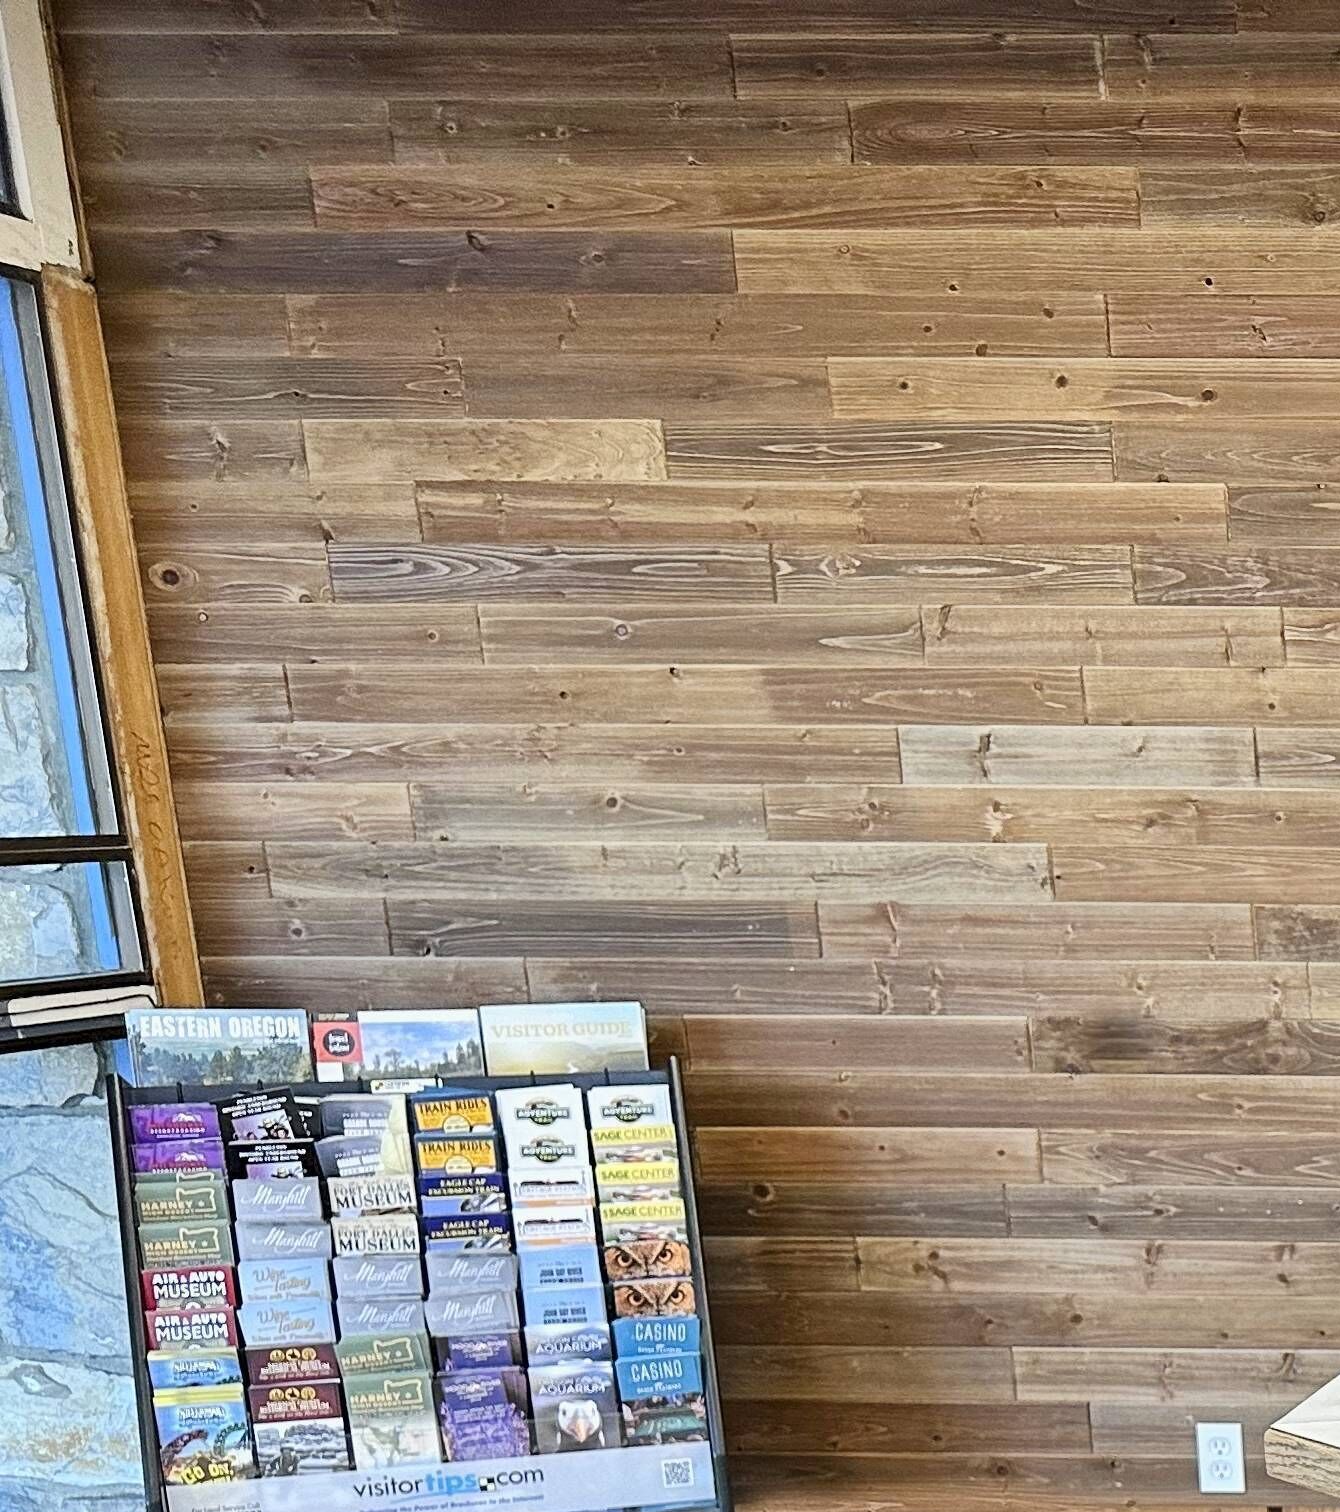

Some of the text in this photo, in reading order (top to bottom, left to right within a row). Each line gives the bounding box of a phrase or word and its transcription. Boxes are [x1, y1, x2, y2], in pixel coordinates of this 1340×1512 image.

[140, 1015, 300, 1039] EASTERN OREGON
[491, 1021, 632, 1038] VISITOR GUIDE
[420, 1099, 487, 1114] TRAIN RIDES
[594, 1127, 667, 1141] SAGE CENTER
[423, 1141, 491, 1152] TRAIN RIDES
[601, 1168, 674, 1180] SAGE CENTER
[141, 1200, 192, 1210] HARNEY
[335, 1192, 412, 1210] MUSEUM
[609, 1205, 682, 1217] SAGE CENTER
[144, 1240, 196, 1250] HARNEY
[339, 1237, 416, 1252] MUSEUM
[152, 1272, 180, 1285] AIR
[189, 1271, 225, 1282] AUTO
[154, 1282, 227, 1299] MUSEUM
[155, 1315, 180, 1327] AIR
[191, 1313, 227, 1325] AUTO
[155, 1324, 228, 1342] MUSEUM
[635, 1323, 686, 1342] CASINO
[535, 1341, 602, 1354] AQUARIUM
[341, 1352, 390, 1366] HARNEY
[631, 1360, 683, 1382] CASINO
[539, 1382, 606, 1395] AQUARIUM
[350, 1392, 400, 1403] HARNEY
[181, 1466, 205, 1484] GO
[414, 1504, 438, 1512] Power
